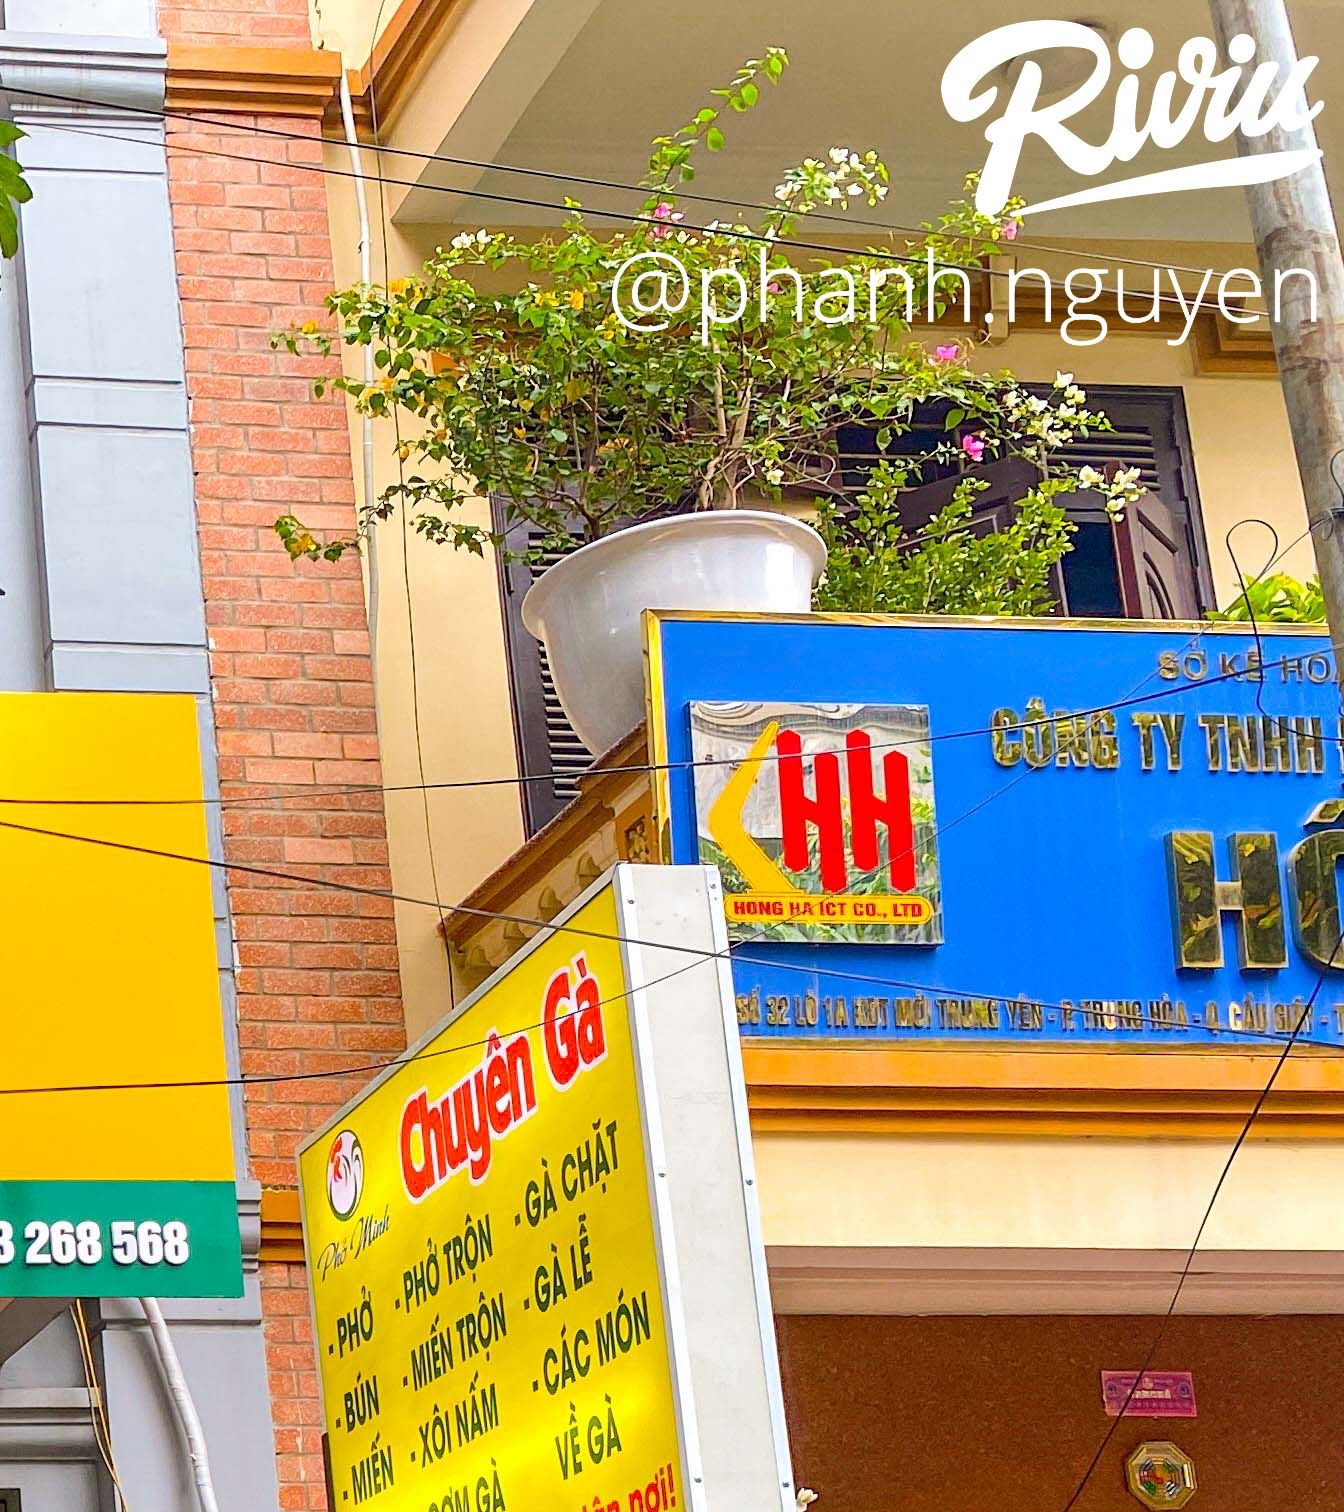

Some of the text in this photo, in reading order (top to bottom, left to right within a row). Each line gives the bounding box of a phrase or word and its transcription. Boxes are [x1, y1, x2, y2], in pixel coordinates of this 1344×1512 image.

[990, 697, 1120, 770] CÔNG
[1132, 711, 1187, 772] TY
[1198, 713, 1325, 775] TNHH
[733, 901, 784, 916] HONG
[819, 902, 847, 916] ICT
[892, 903, 922, 917] LTD
[767, 996, 790, 1025] 32
[936, 998, 999, 1030] TRUNG
[1080, 999, 1143, 1032] TRUNG
[399, 950, 608, 1204] Chuyên Gà
[525, 1117, 619, 1228] GÀ CHẶT
[24, 1221, 102, 1267] 268
[111, 1221, 189, 1267] 568
[350, 1204, 390, 1259] Minh
[403, 1213, 493, 1314] PHỞ TRỘN
[534, 1243, 568, 1313] GÀ
[337, 1285, 374, 1359] PHỞ
[411, 1291, 507, 1392] MIẾN TRỘN
[543, 1287, 651, 1396] CÁC MÓN
[344, 1371, 380, 1433] BÚN
[419, 1369, 499, 1469] XÔI NẤM
[555, 1392, 622, 1481] VỀ GÀ
[351, 1432, 394, 1506] MIẾN
